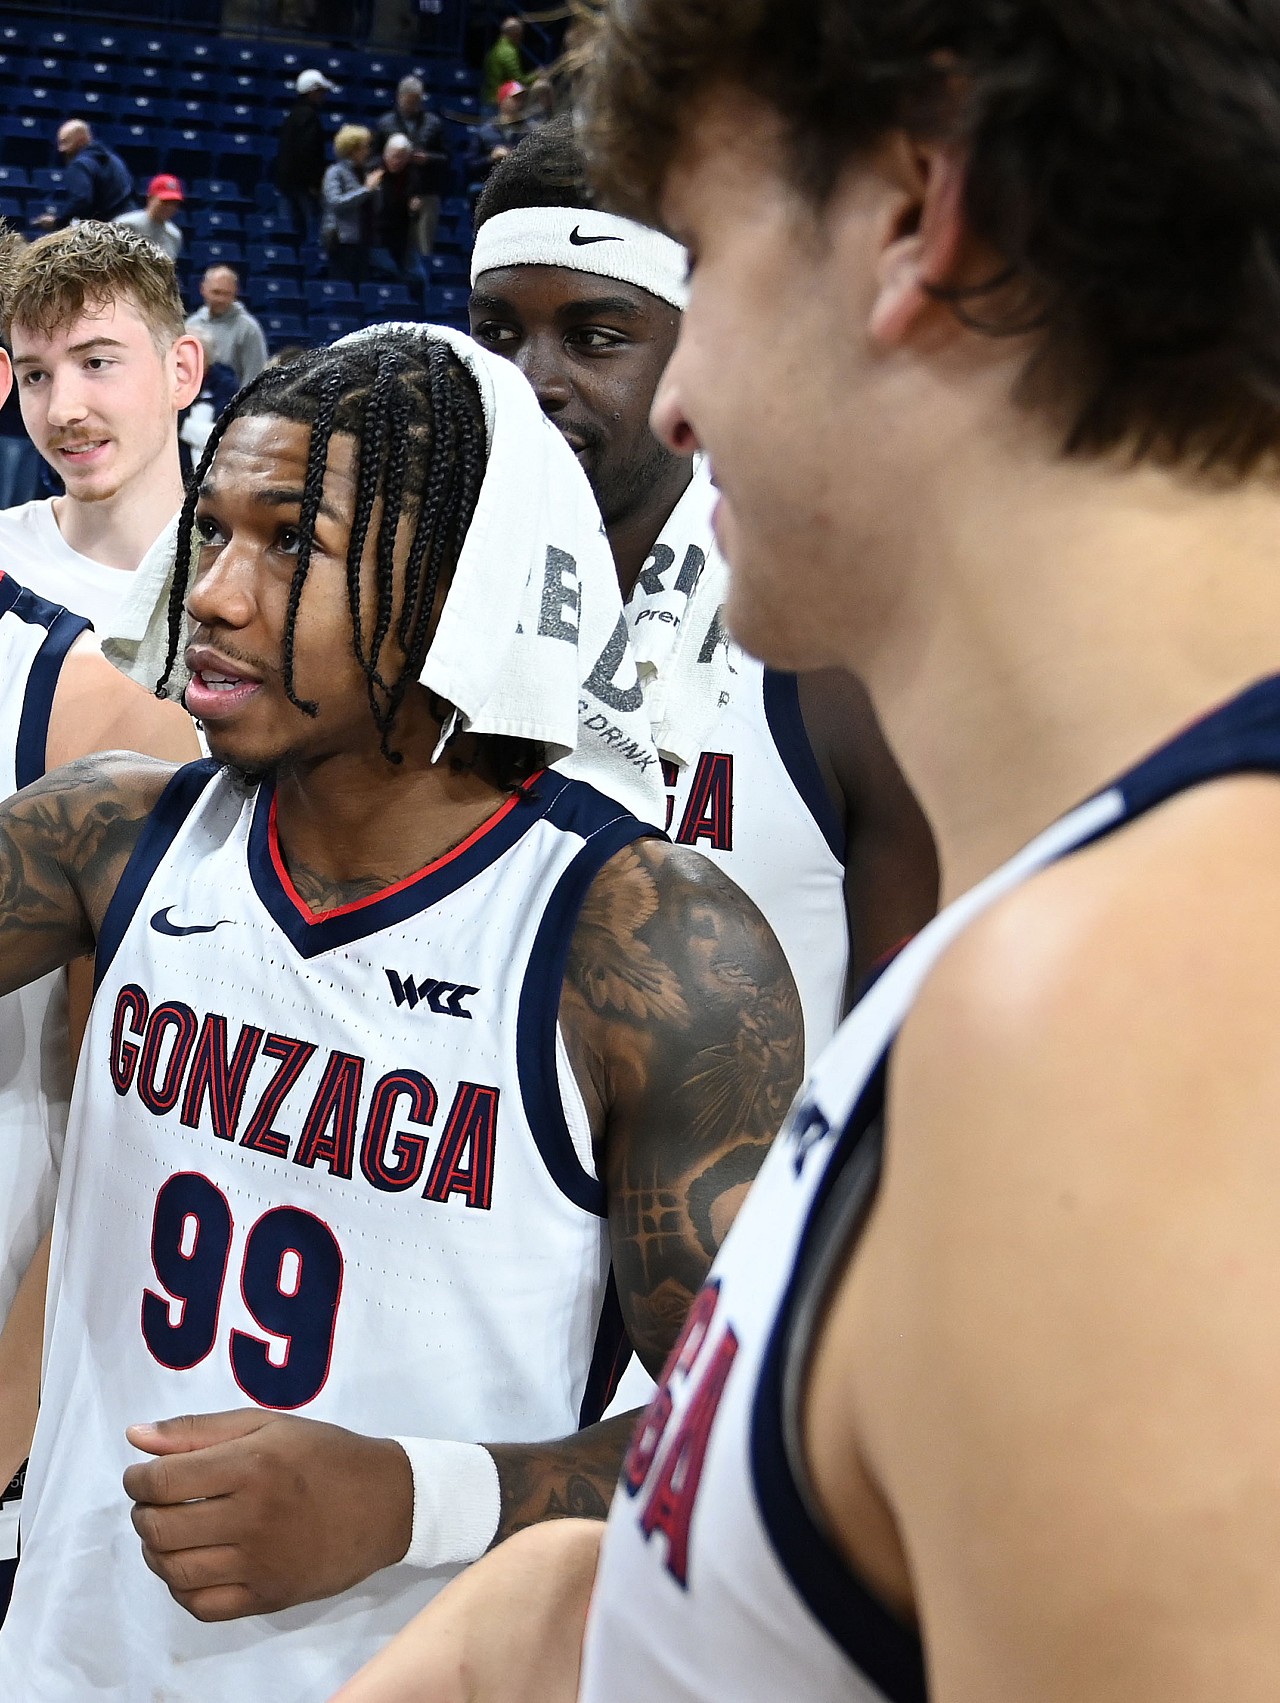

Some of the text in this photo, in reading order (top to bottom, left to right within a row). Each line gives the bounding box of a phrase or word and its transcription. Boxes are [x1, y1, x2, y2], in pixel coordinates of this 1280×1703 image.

[583, 713, 658, 774] DRINK
[384, 968, 480, 1020] WCC
[109, 983, 501, 1211] GONZAGA
[141, 1170, 345, 1411] 99
